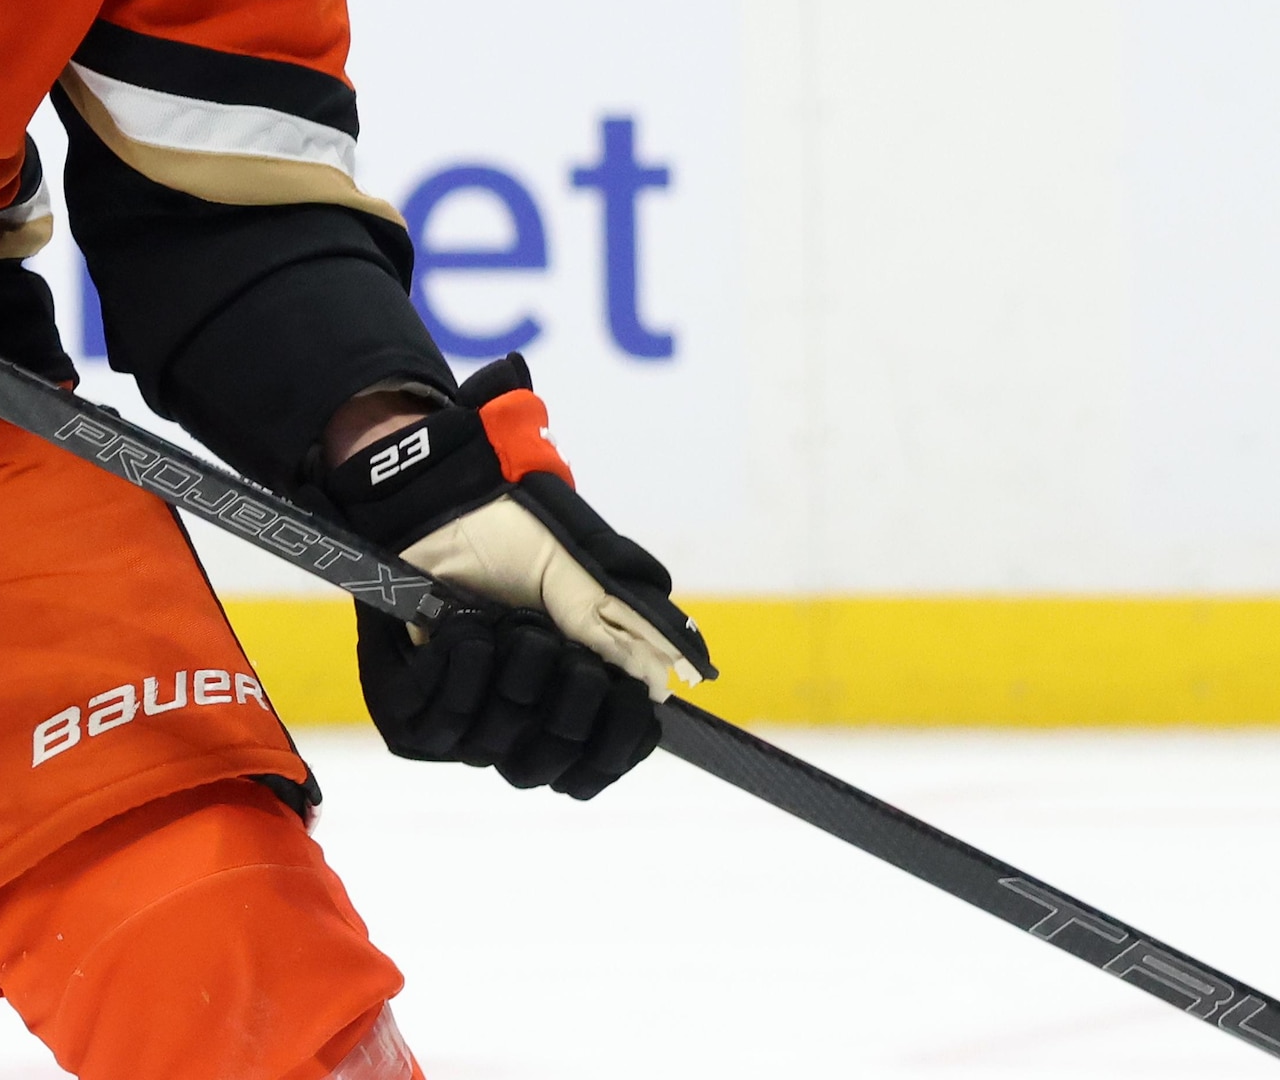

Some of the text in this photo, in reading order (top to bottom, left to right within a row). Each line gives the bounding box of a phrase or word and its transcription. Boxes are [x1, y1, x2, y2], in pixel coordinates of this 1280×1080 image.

[54, 414, 363, 570] PROJECT
[339, 563, 433, 606] X
[369, 427, 431, 486] 23
